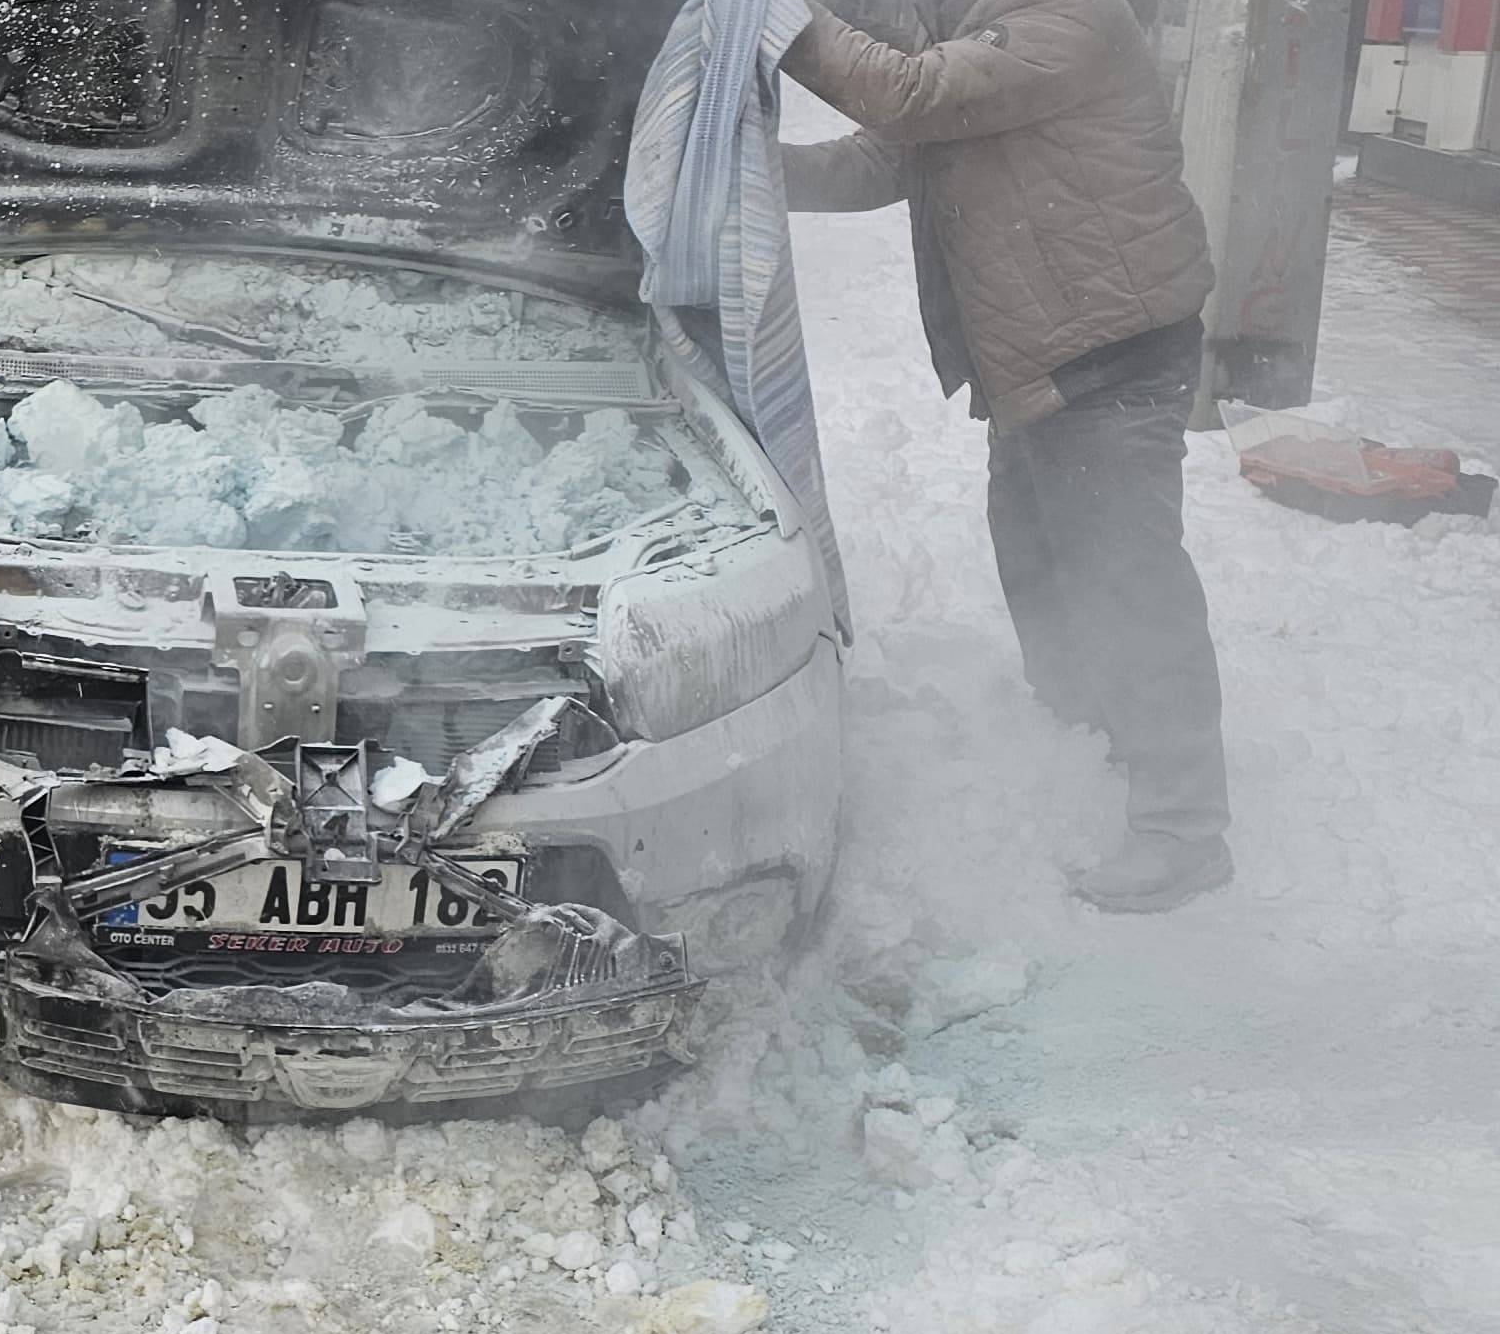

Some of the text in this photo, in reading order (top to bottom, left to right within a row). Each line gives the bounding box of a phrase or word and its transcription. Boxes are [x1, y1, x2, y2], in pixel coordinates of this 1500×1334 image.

[260, 867, 368, 926] ABH
[409, 869, 508, 926] 182
[110, 933, 175, 946] OTO CENTER
[318, 935, 404, 954] AUTO
